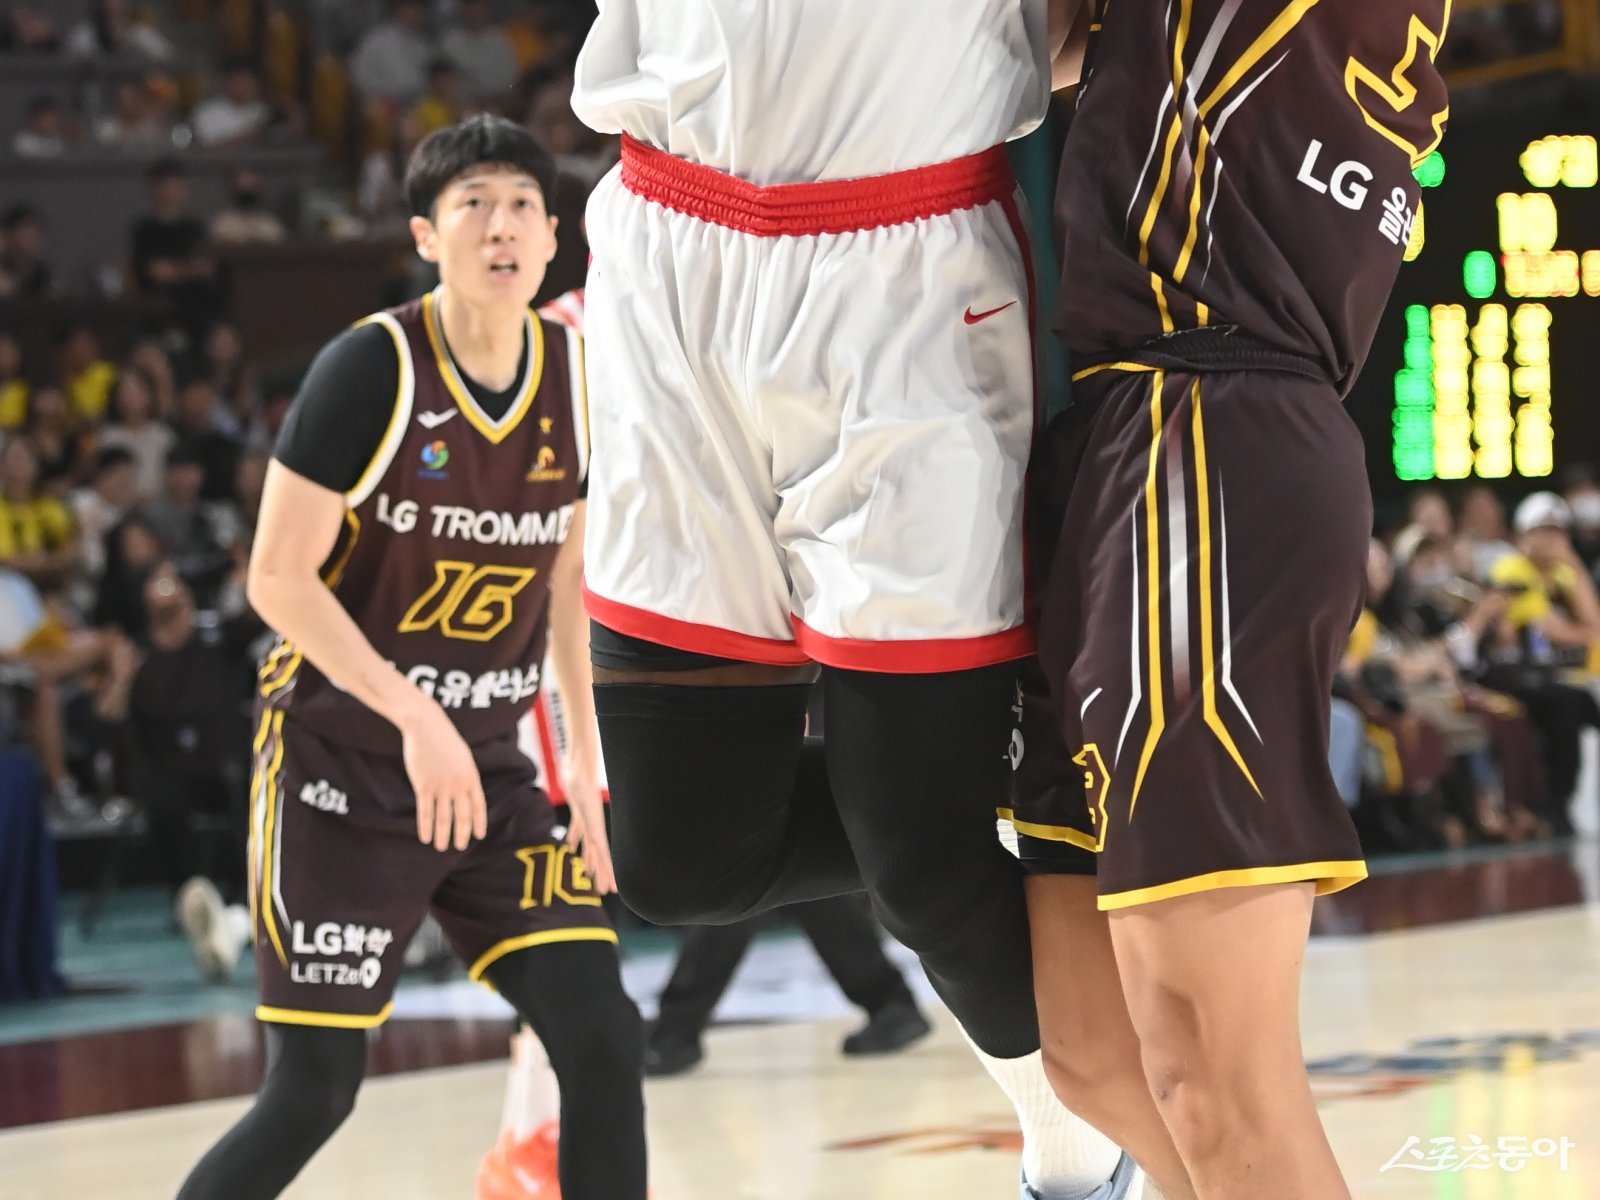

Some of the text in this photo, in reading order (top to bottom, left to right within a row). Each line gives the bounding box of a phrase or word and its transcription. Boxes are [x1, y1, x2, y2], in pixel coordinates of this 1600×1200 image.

[1296, 138, 1374, 211] LG
[375, 493, 419, 534] LG
[397, 559, 538, 642] 16
